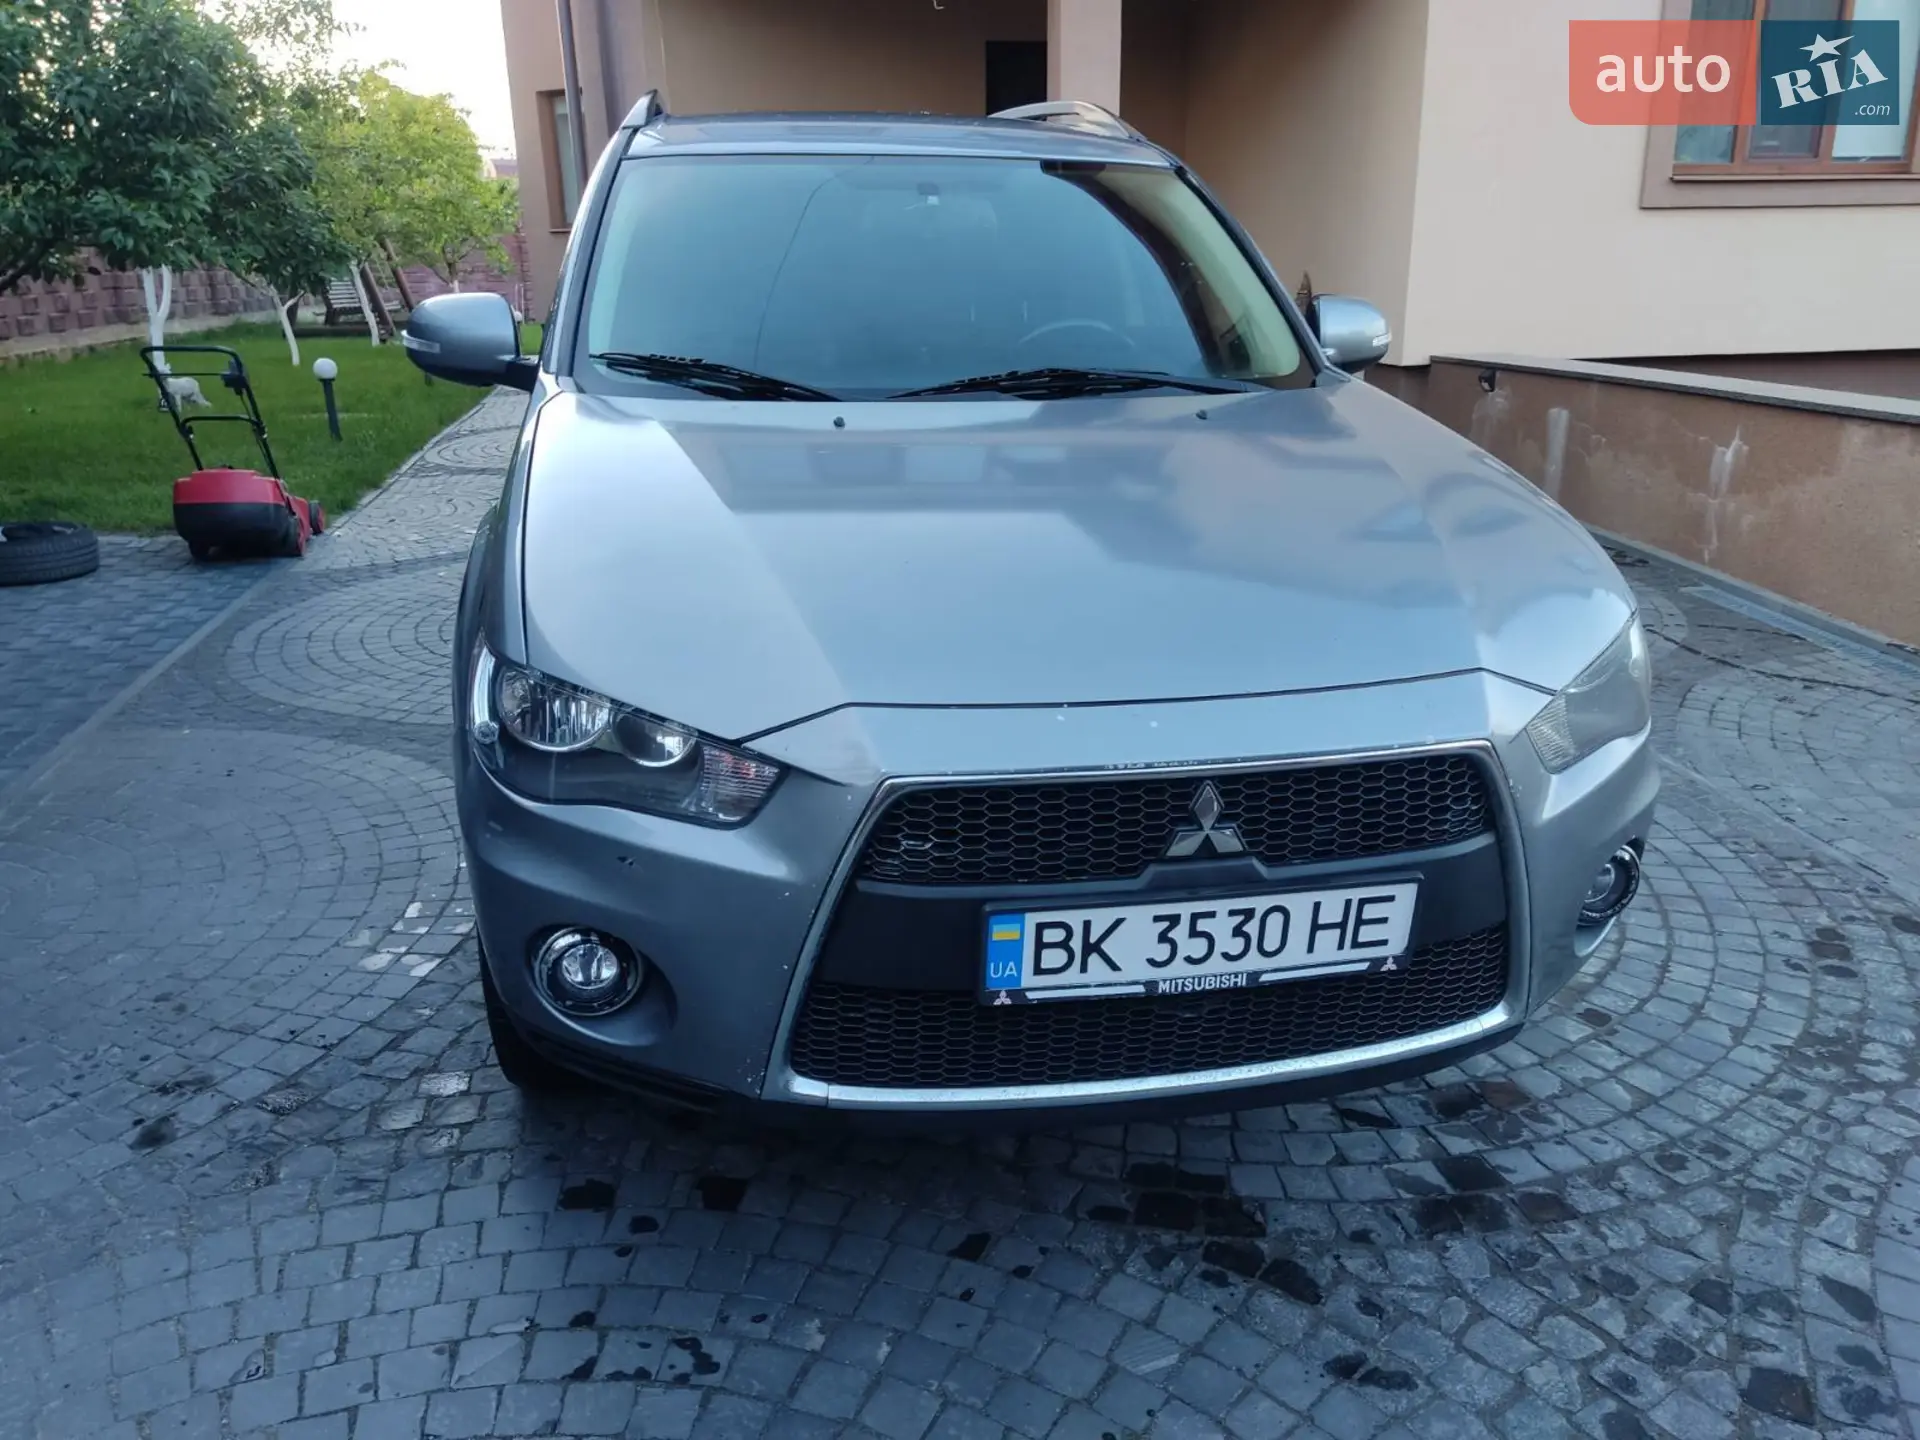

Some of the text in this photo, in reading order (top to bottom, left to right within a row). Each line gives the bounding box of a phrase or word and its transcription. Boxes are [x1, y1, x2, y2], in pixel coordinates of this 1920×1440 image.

[1032, 895, 1396, 977] BK 3530 HE
[990, 962, 1018, 979] UA
[1158, 973, 1248, 994] MITSUBISHI
